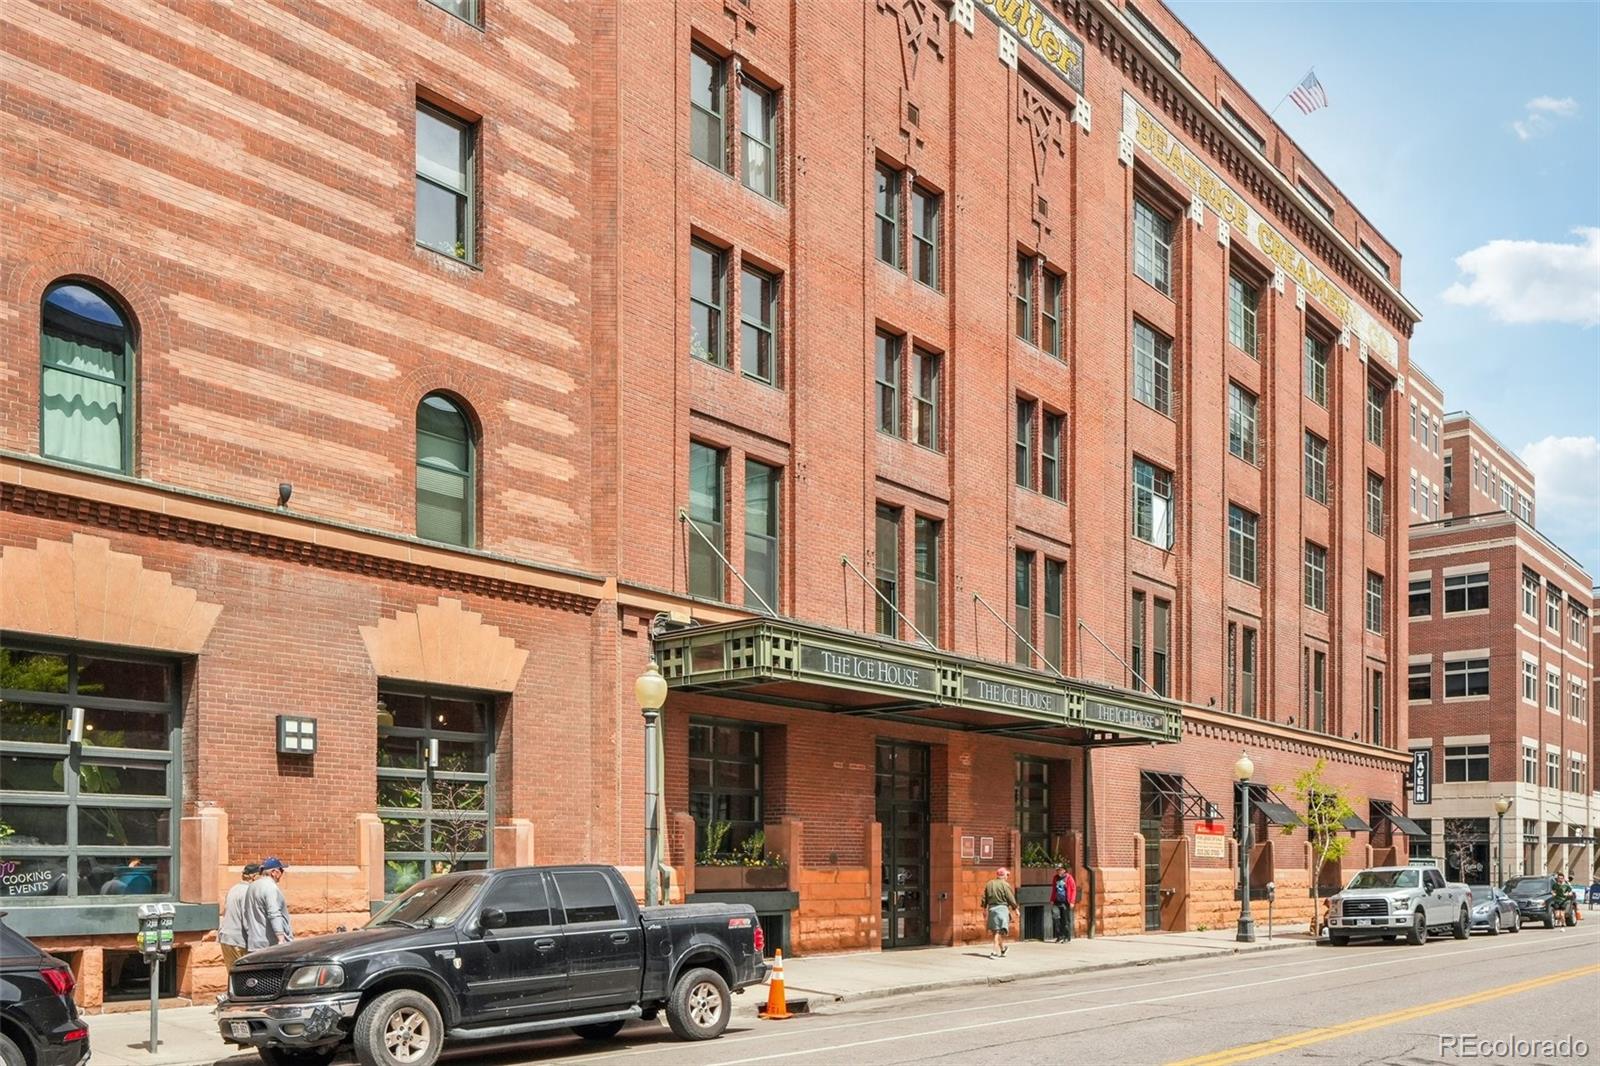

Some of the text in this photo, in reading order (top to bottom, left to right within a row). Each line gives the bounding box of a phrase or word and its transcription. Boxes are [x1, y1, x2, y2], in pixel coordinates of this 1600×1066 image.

[984, 0, 1077, 74] utter
[1136, 108, 1248, 235] BEATRICE
[1258, 222, 1359, 325] CREAMER
[821, 651, 919, 687] THE ICE HOUSE
[977, 681, 1052, 710] THE ICE HOUSE
[1097, 704, 1154, 728] THE ICE HOUSE
[1416, 753, 1425, 801] TAVERN
[2, 870, 52, 885] COOKING
[9, 881, 49, 895] EVENTS
